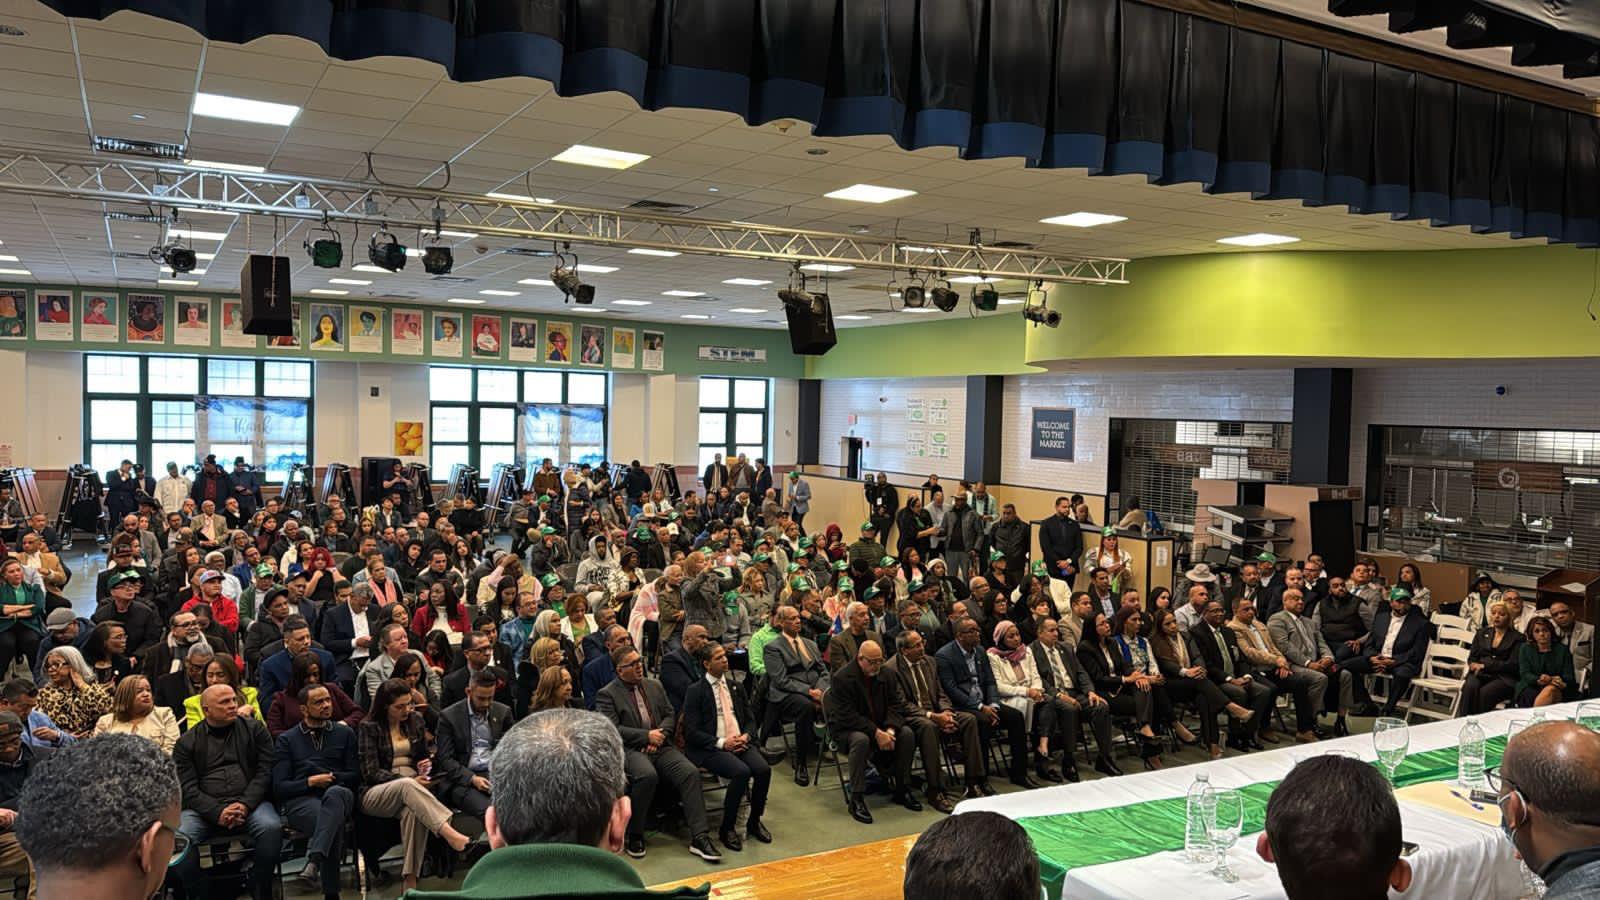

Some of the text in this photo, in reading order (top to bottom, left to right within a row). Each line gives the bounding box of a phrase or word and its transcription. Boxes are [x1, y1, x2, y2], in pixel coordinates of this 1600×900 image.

[710, 348, 756, 360] STEM
[1036, 421, 1070, 430] WELCOME
[1040, 431, 1064, 440] TO THE
[1039, 440, 1067, 449] MARKET
